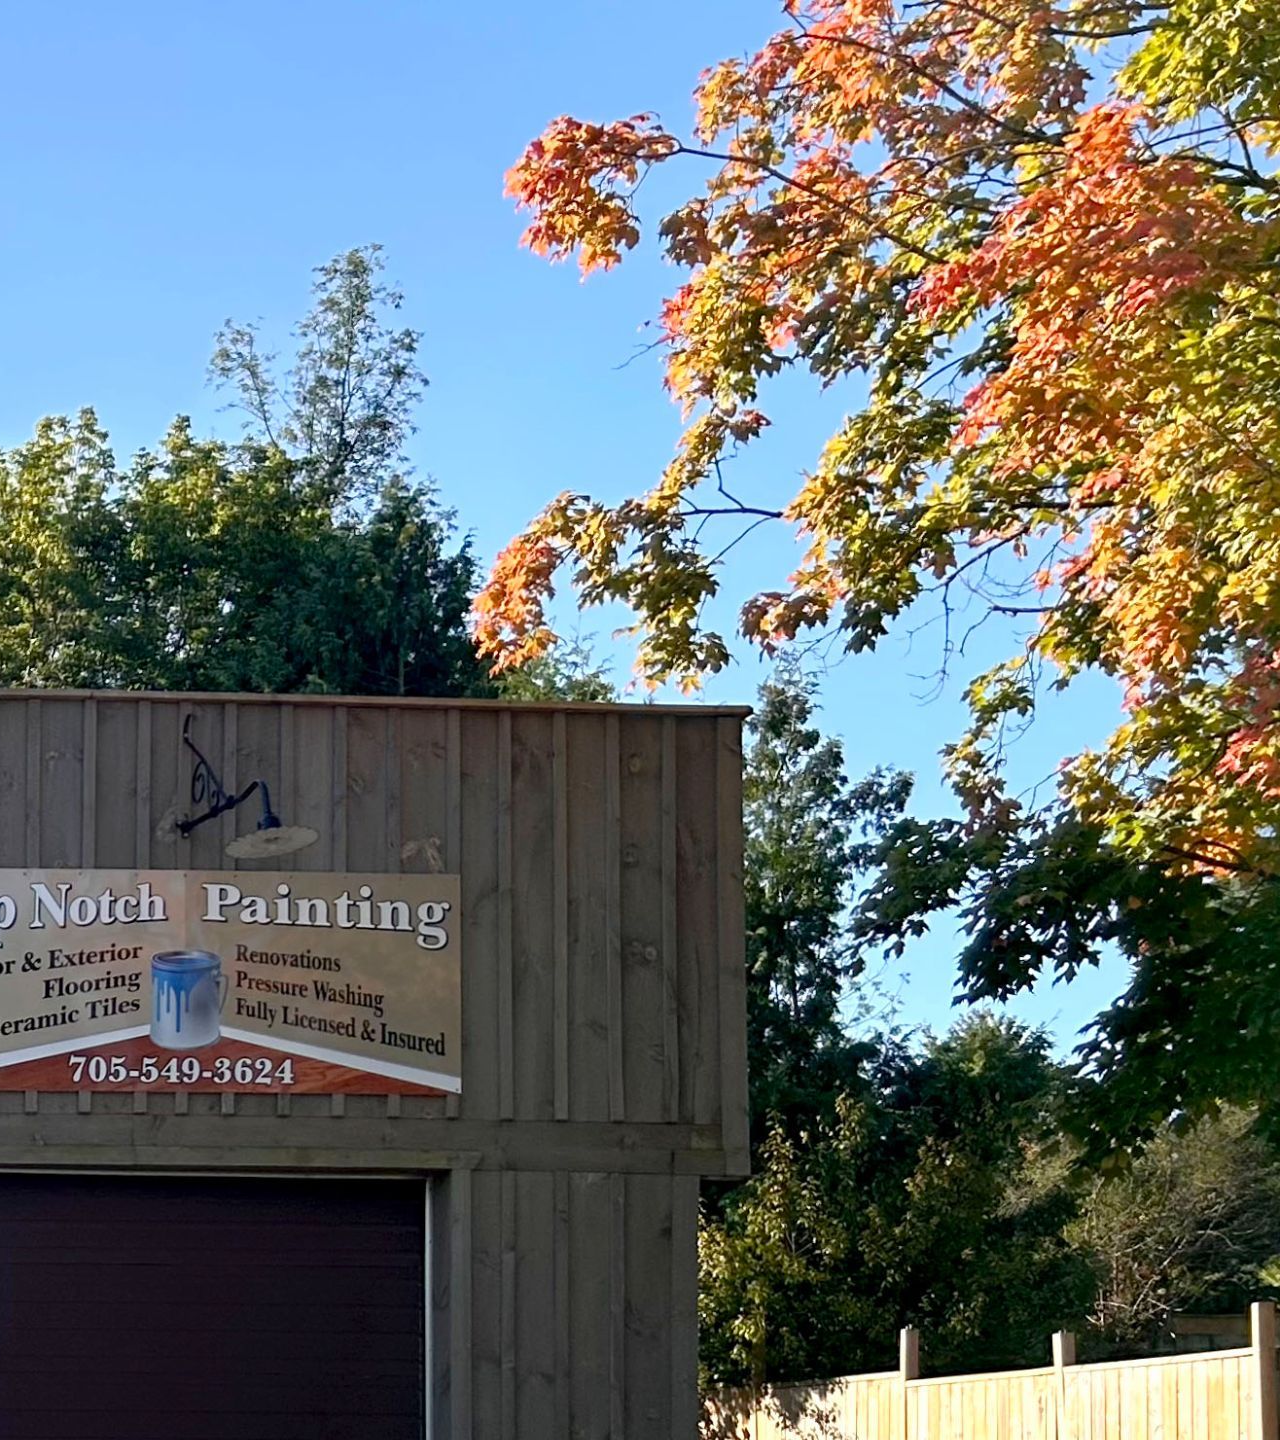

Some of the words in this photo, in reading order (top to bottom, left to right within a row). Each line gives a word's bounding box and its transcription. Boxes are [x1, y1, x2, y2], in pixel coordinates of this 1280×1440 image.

[30, 882, 168, 928] Notch
[201, 883, 451, 950] Painting
[21, 951, 41, 973] &
[48, 944, 143, 969] Exterior
[235, 944, 341, 972] Renovations
[43, 971, 142, 999] Flooring
[235, 971, 308, 998] Pressure
[314, 980, 384, 1018] Washing
[86, 998, 140, 1020] Tiles
[235, 998, 277, 1028] Fully
[282, 1006, 356, 1038] Licensed
[361, 1019, 376, 1043] &
[380, 1023, 446, 1056] Insured
[68, 1054, 295, 1086] 705-549-3624
